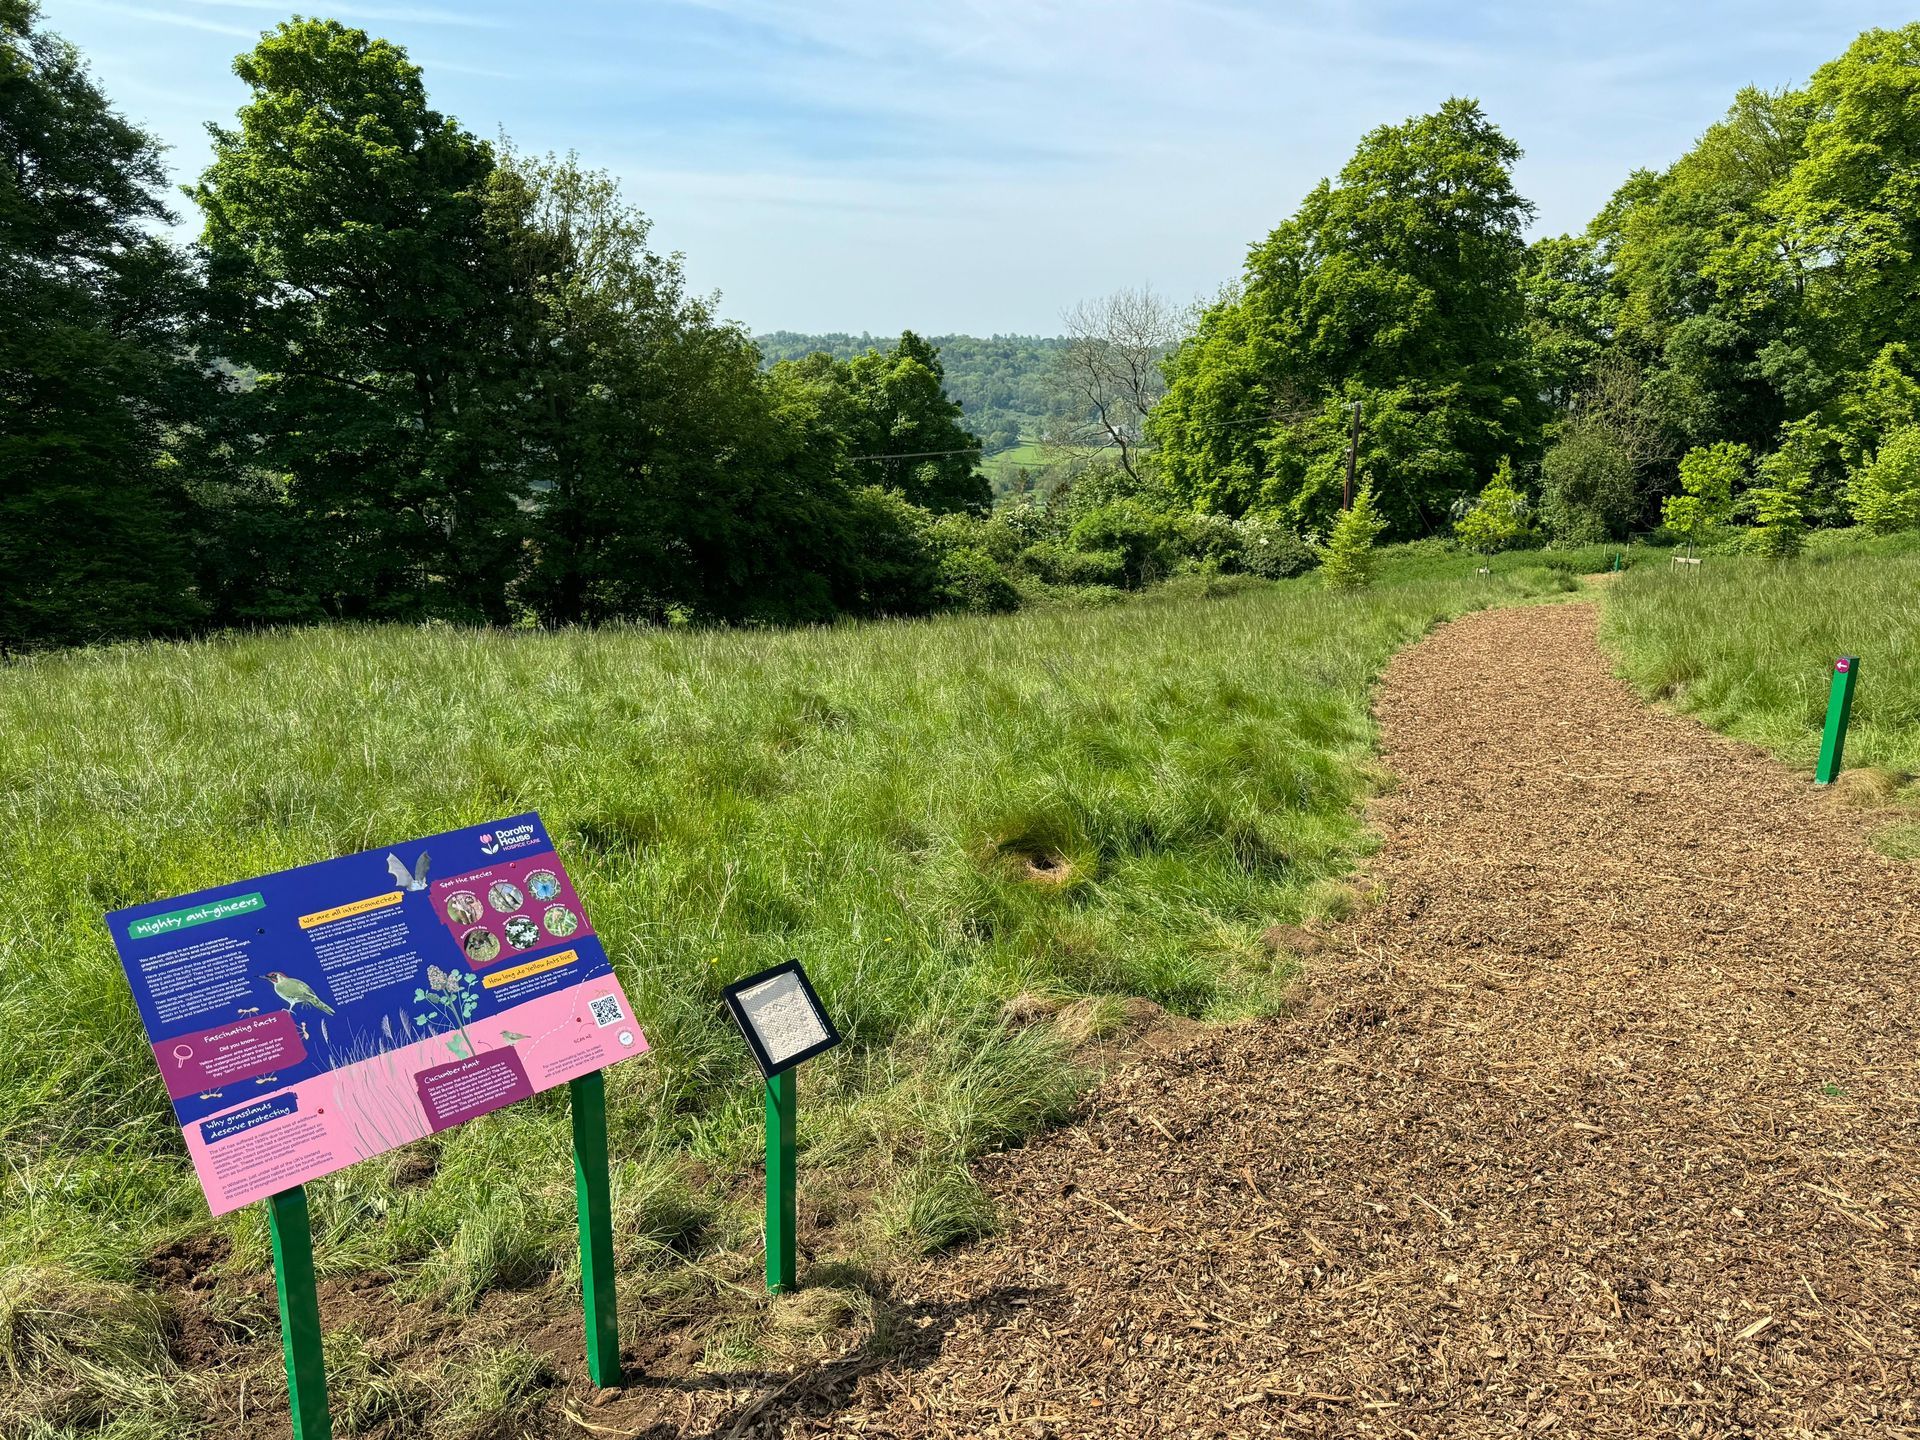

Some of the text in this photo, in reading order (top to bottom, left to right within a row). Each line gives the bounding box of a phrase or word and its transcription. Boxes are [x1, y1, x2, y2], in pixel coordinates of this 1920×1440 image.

[495, 825, 534, 841] Dorothy
[499, 834, 530, 846] House
[503, 842, 526, 851] HOSPICE
[439, 880, 454, 888] Spot
[469, 871, 492, 881] species
[342, 895, 398, 913] interconnected
[137, 898, 258, 934] Mighty ant-gineers
[525, 964, 545, 972] Yellow
[546, 958, 560, 966] Ants
[559, 952, 574, 960] live?
[204, 1017, 277, 1043] Fascinating facts
[424, 1060, 480, 1084] Cucumber plant
[206, 1103, 272, 1129] Why grasslands
[211, 1107, 290, 1139] deserve protecting
